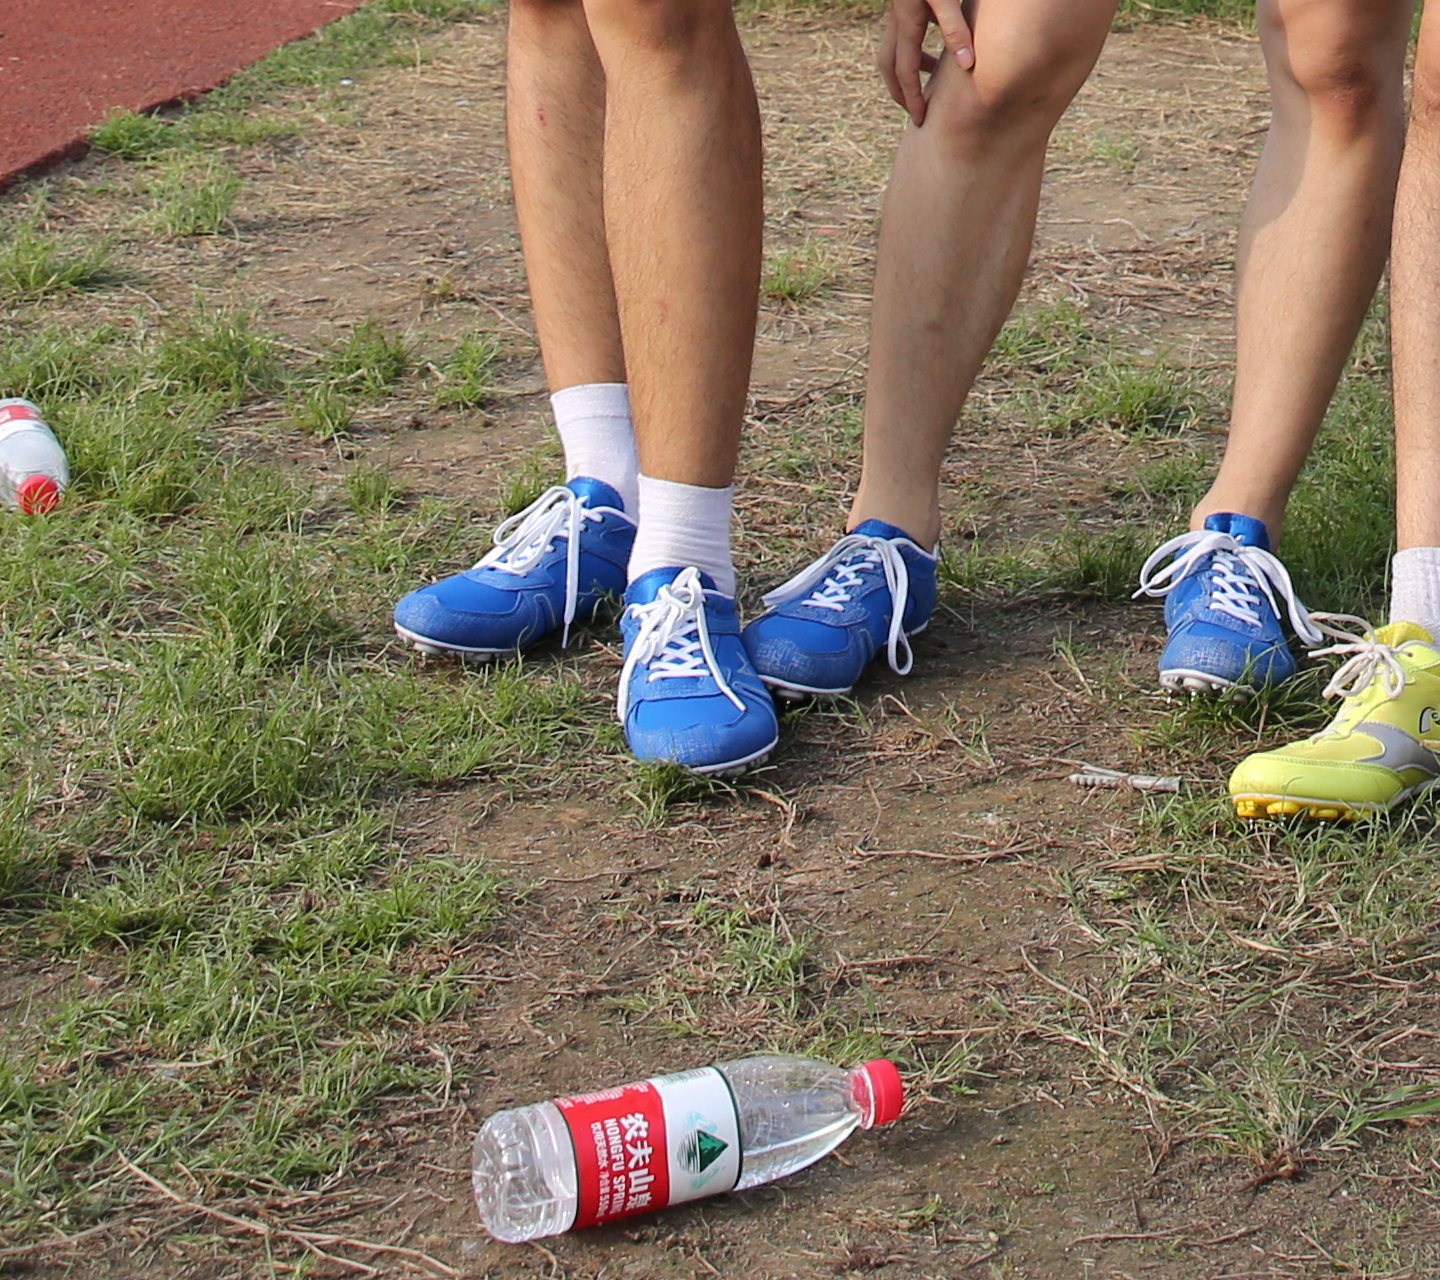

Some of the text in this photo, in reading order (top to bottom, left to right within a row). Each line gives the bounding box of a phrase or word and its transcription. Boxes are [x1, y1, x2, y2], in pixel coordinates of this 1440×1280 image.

[603, 1117, 625, 1172] NONGFU
[620, 1112, 655, 1210] 农夫山泉
